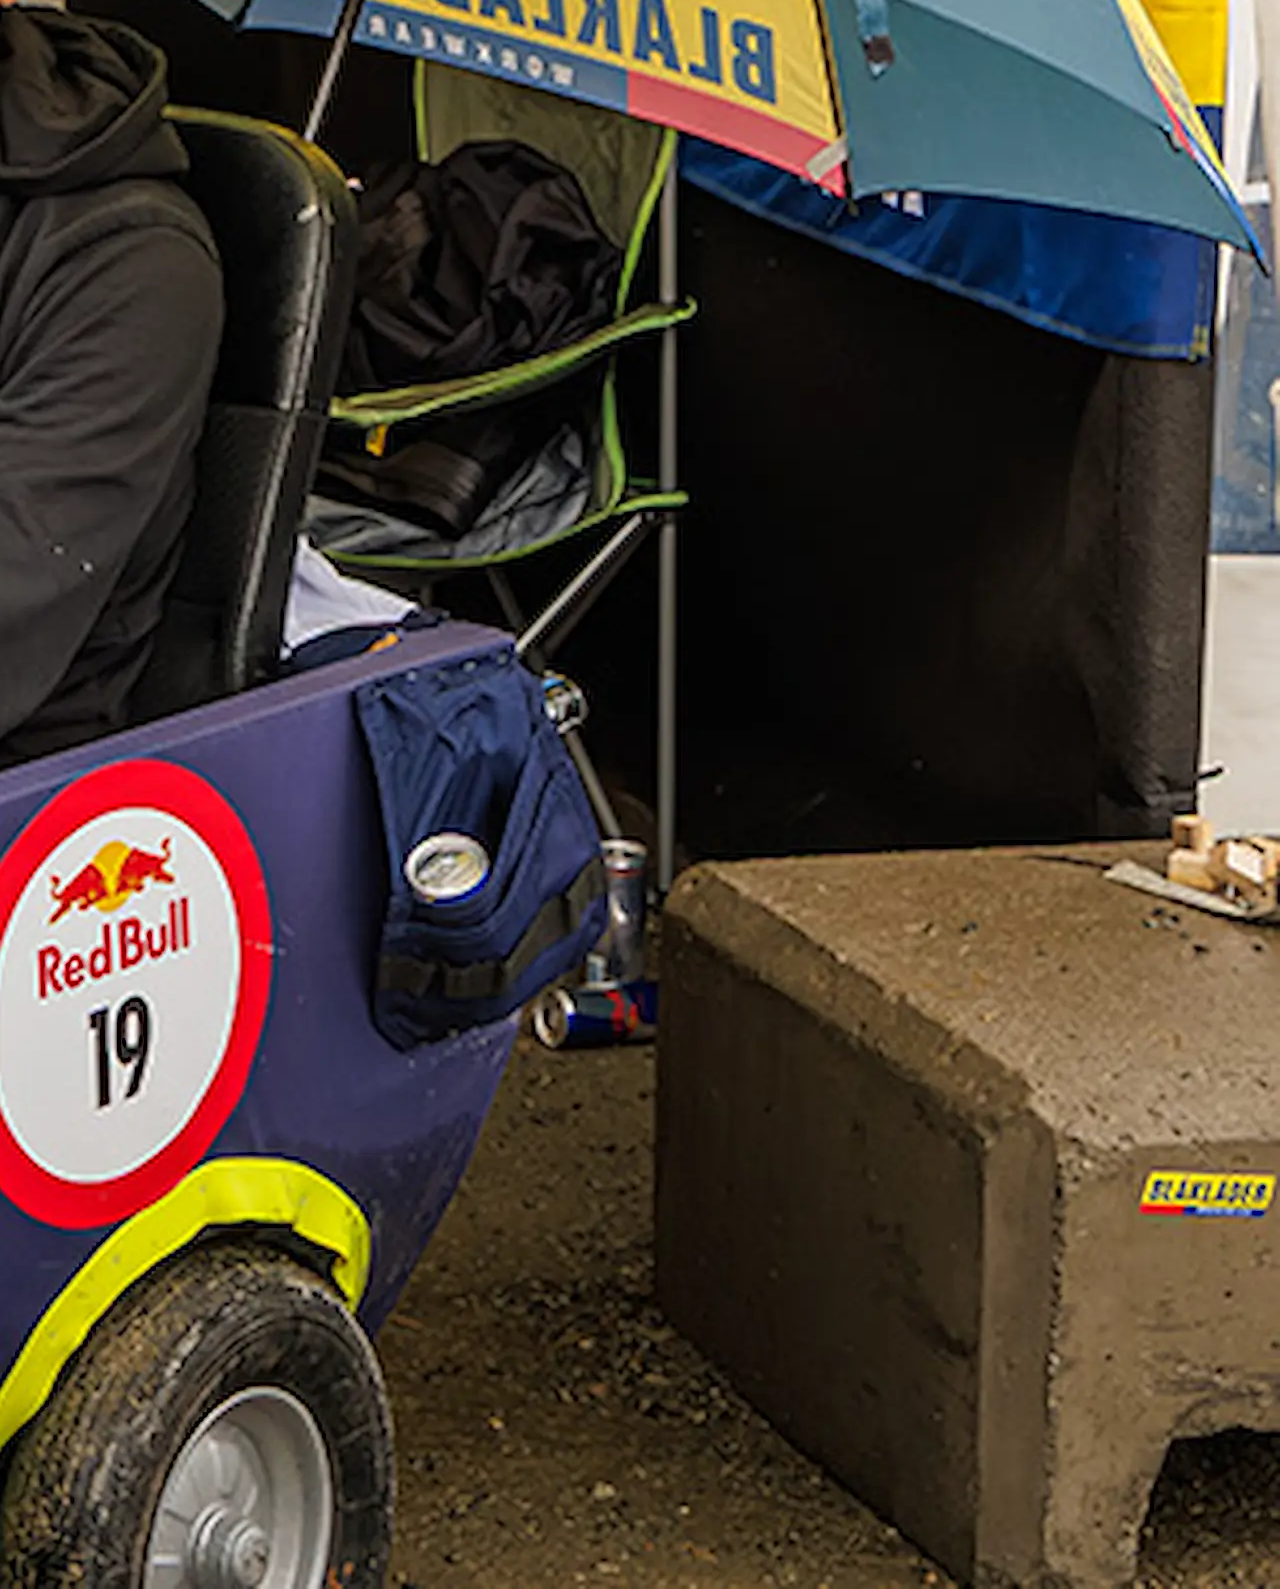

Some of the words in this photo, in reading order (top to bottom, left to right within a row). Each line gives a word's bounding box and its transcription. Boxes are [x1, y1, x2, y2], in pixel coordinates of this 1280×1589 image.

[38, 923, 112, 1000] Red
[119, 897, 191, 971] Bull
[88, 996, 152, 1109] 19
